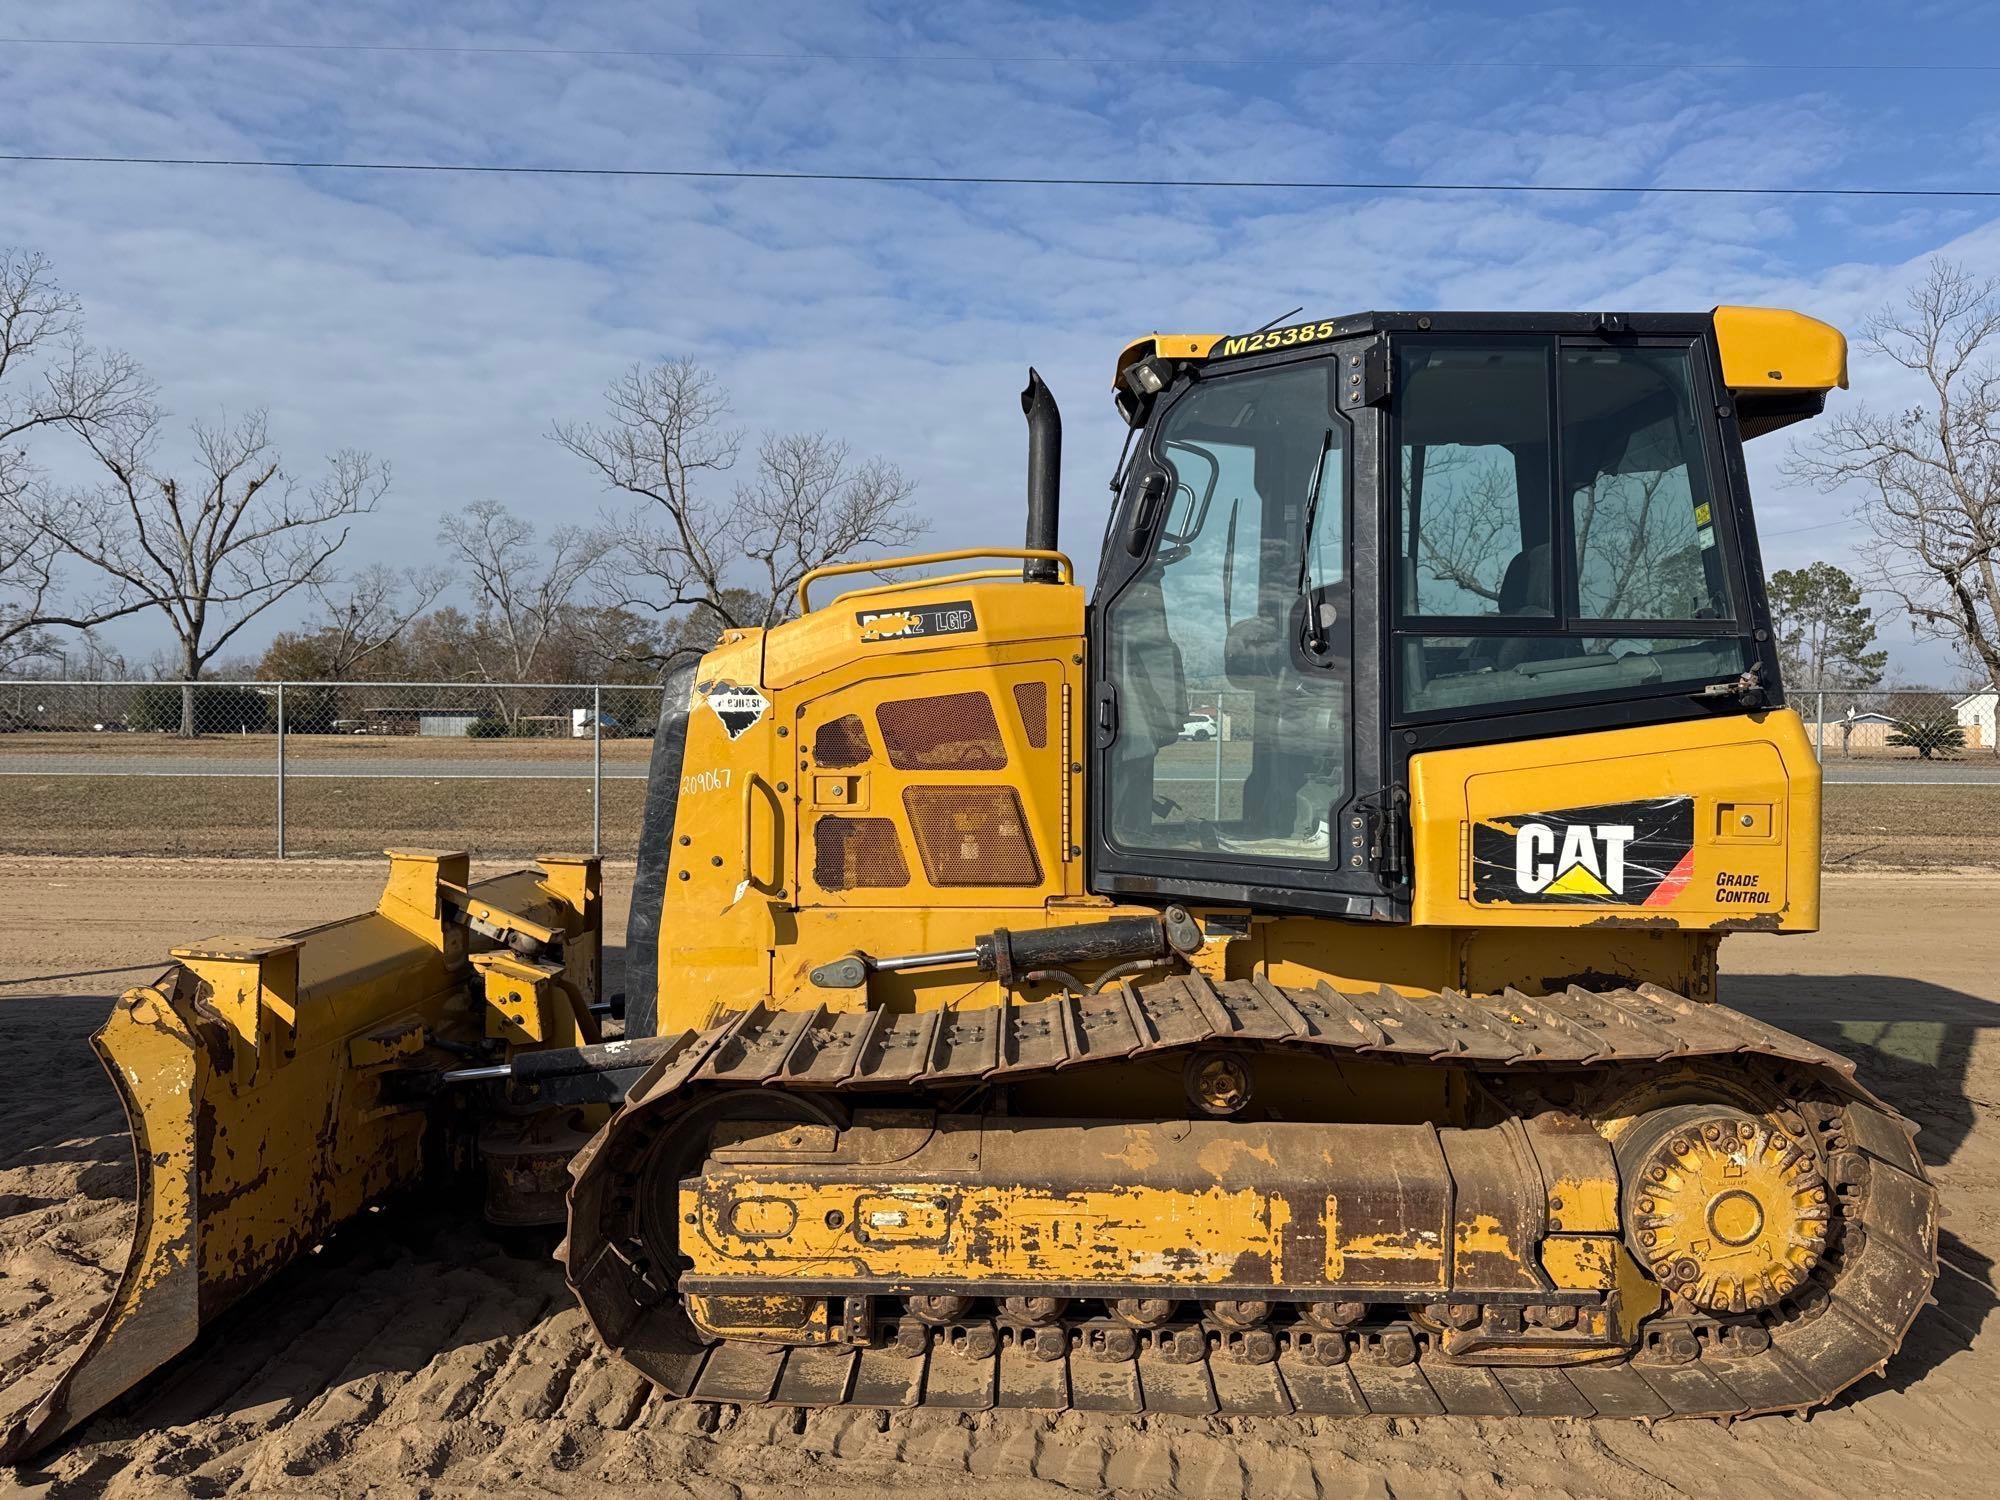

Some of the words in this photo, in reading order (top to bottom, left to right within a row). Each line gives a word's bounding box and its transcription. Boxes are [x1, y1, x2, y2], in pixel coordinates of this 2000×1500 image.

[1224, 321, 1334, 355] M25385
[935, 610, 971, 632] LGP
[681, 768, 731, 795] 209067
[1516, 823, 1634, 894] CAT
[1716, 872, 1759, 887] GRADE
[1715, 888, 1771, 903] CONTROL
